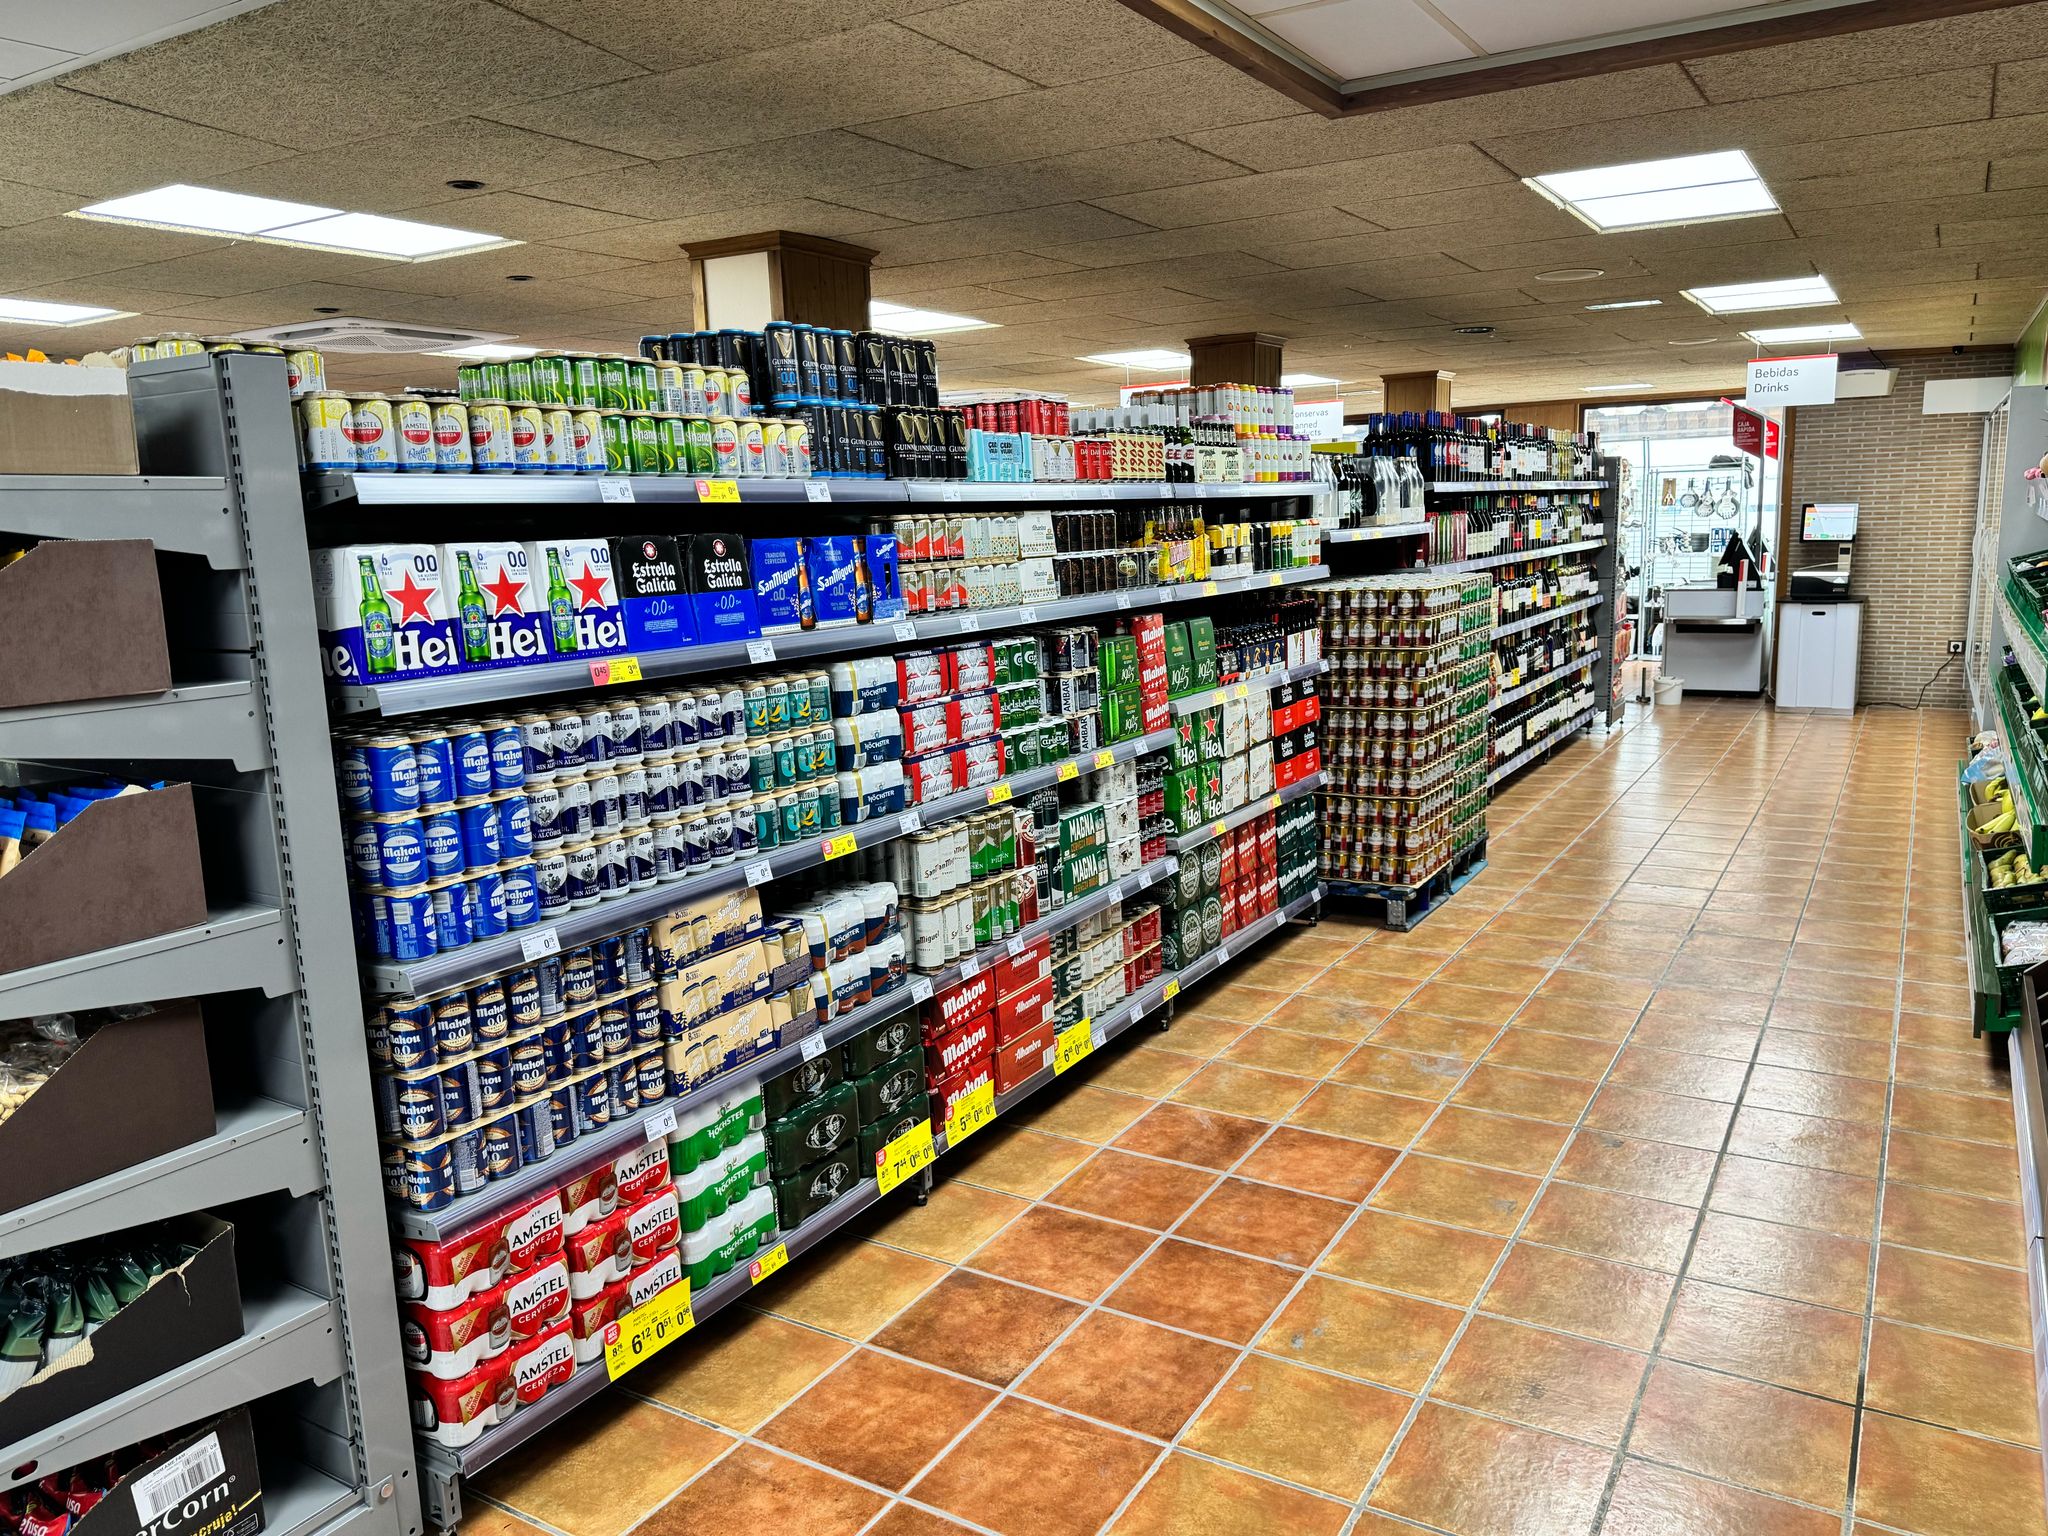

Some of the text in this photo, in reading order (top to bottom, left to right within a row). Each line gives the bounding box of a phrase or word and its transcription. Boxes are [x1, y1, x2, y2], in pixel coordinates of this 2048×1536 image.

[1755, 368, 1799, 379] Bebidas
[1754, 382, 1790, 393] Drinks
[405, 422, 429, 430] AMSTEL
[1294, 410, 1329, 418] onservas
[381, 553, 388, 566] 6
[413, 554, 438, 573] 0.0
[477, 549, 484, 561] 6
[507, 551, 527, 568] 0.0
[564, 546, 571, 558] 6
[590, 547, 610, 564] 0.0
[632, 562, 676, 578] Estrella
[704, 558, 743, 574] Estrella
[636, 577, 677, 594] Galicia
[707, 573, 743, 589] Galicia
[488, 618, 548, 661] Hei
[575, 611, 628, 651] Hei
[393, 626, 459, 672] Hei
[1121, 664, 1135, 685] 1925
[1171, 665, 1190, 692] 1925
[1198, 658, 1215, 684] 1925
[1063, 679, 1071, 712] AMBAR
[1081, 717, 1089, 749] AMBAR
[1125, 714, 1138, 735] 1925
[1069, 813, 1095, 842] MAGNA
[383, 844, 421, 858] Mahou
[425, 836, 459, 850] Mahou
[434, 846, 448, 854] SIN
[396, 855, 409, 863] SIN
[1071, 853, 1099, 885] MAGNA
[511, 898, 524, 906] SIN
[942, 978, 987, 1020] Mahou
[942, 1024, 987, 1068] Mahou
[707, 1108, 745, 1139] HÖCHSTER
[619, 1148, 666, 1183] AMSTEL
[624, 1167, 661, 1193] CERVEZA
[714, 1165, 750, 1197] HÖCHSTER
[512, 1209, 561, 1249] AMSTEL
[633, 1206, 676, 1239] AMSTEL
[518, 1230, 559, 1258] CERVEZA
[638, 1225, 672, 1248] CERVEZA
[719, 1227, 758, 1259] HÖCHSTER
[457, 1258, 466, 1270] PACK
[460, 1252, 474, 1277] AHORRO
[512, 1276, 565, 1315] AMSTEL
[634, 1267, 679, 1304] AMSTEL
[518, 1296, 560, 1324] CERVEZA
[456, 1325, 466, 1335] PACK
[459, 1319, 473, 1344] AHORRO
[518, 1345, 571, 1385] AMSTEL
[524, 1365, 566, 1393] CERVEZA
[463, 1395, 475, 1407] PACK
[467, 1391, 481, 1417] AHORRO
